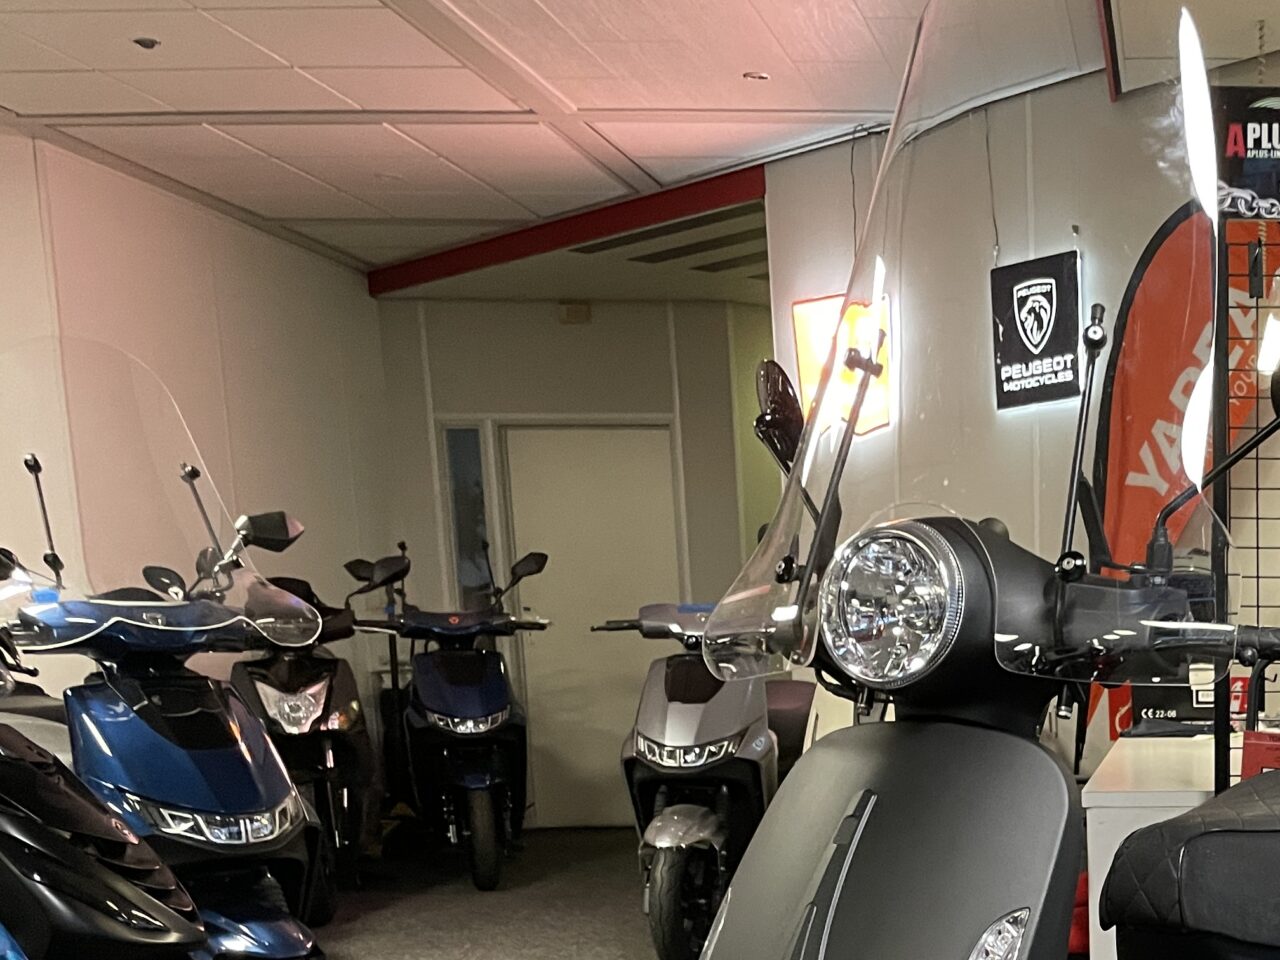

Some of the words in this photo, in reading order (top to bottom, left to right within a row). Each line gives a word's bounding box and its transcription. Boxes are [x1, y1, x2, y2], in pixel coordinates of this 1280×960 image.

[1017, 284, 1052, 298] PEUGEOT
[1000, 353, 1075, 382] PEUGEOT
[1002, 369, 1074, 393] MOTOCYCLES
